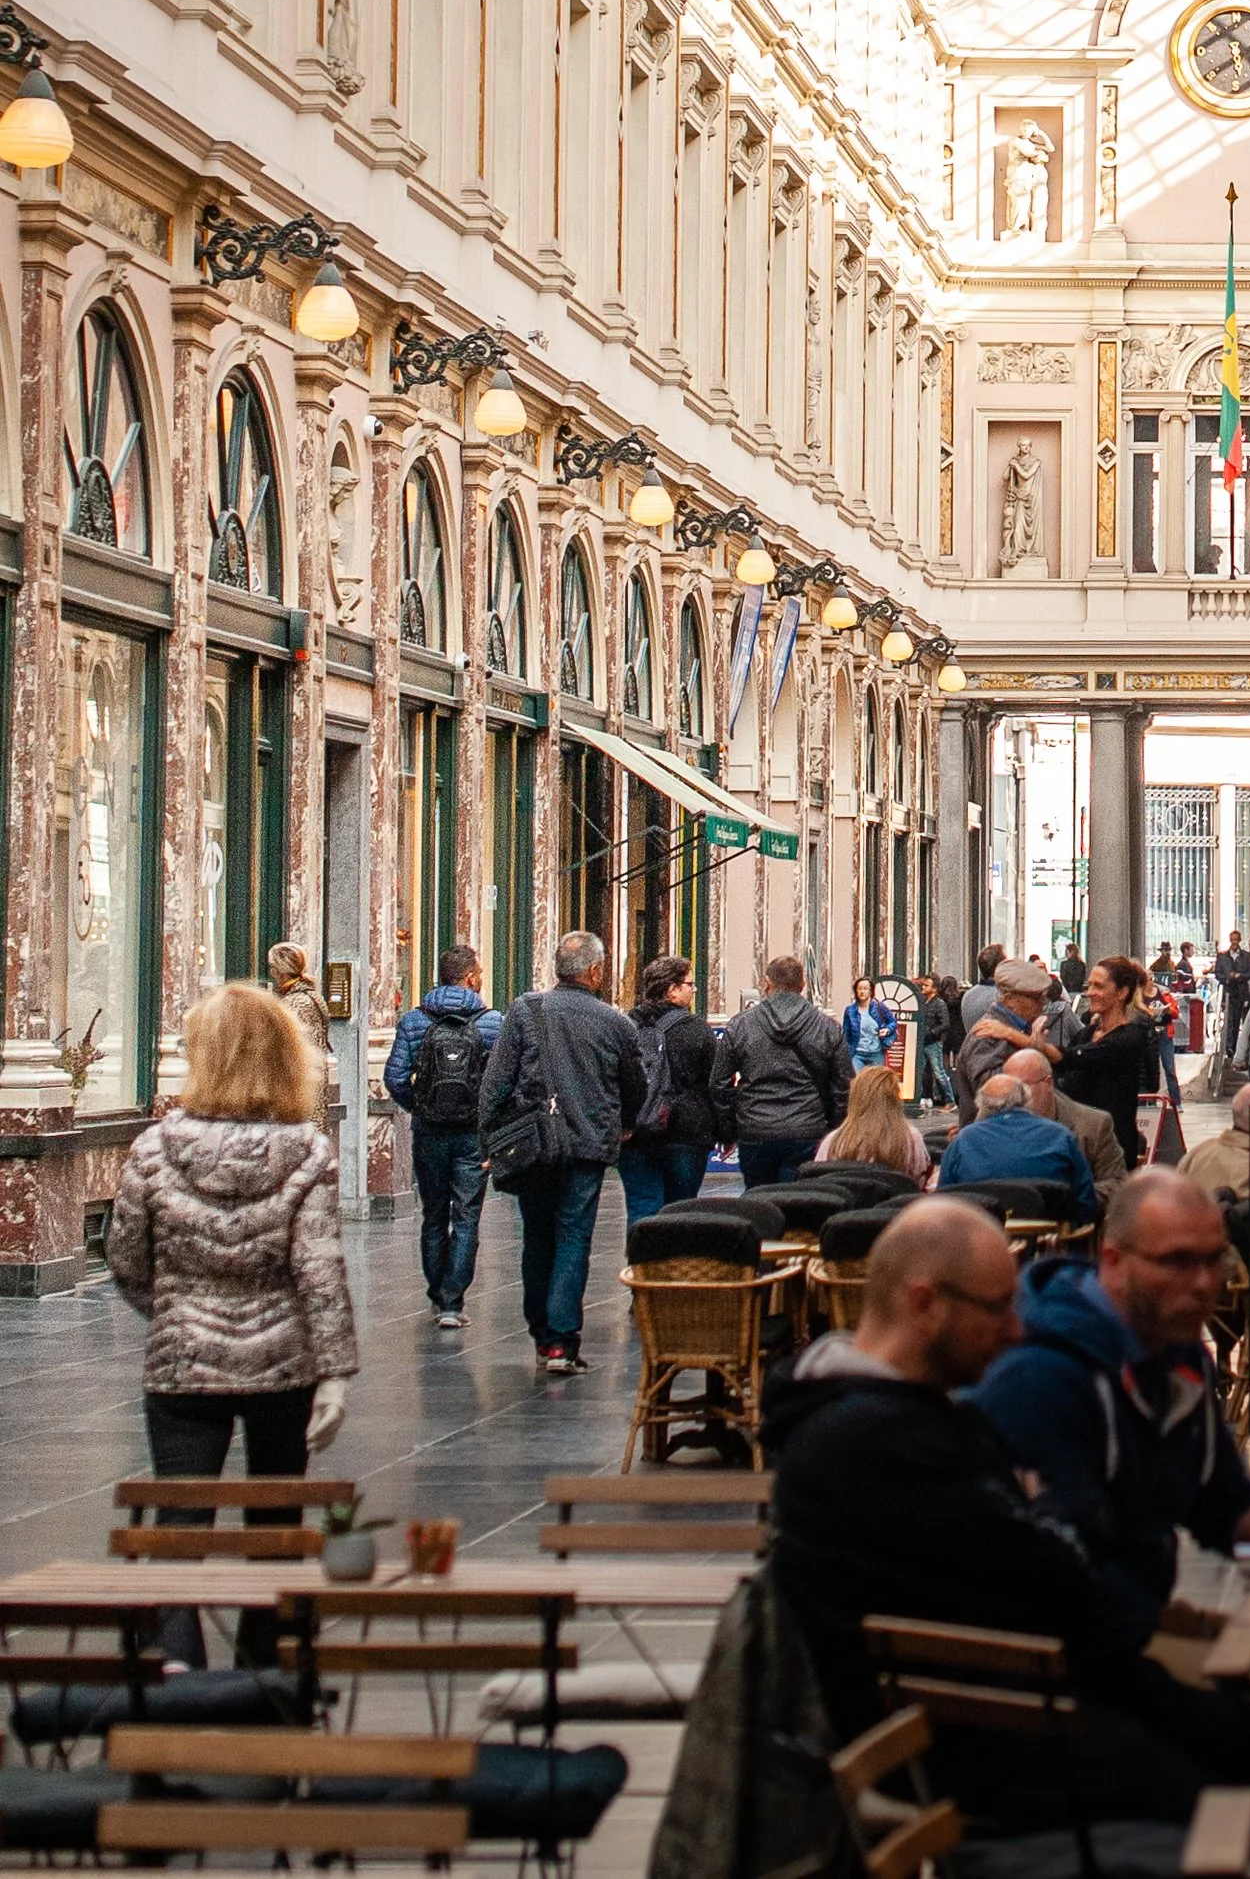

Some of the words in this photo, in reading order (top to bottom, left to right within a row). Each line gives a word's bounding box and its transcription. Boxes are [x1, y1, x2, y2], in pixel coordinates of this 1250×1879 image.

[1232, 12, 1241, 23] N
[1197, 46, 1206, 57] O
[1231, 80, 1240, 91] S
[1131, 673, 1232, 690] GALERIE
